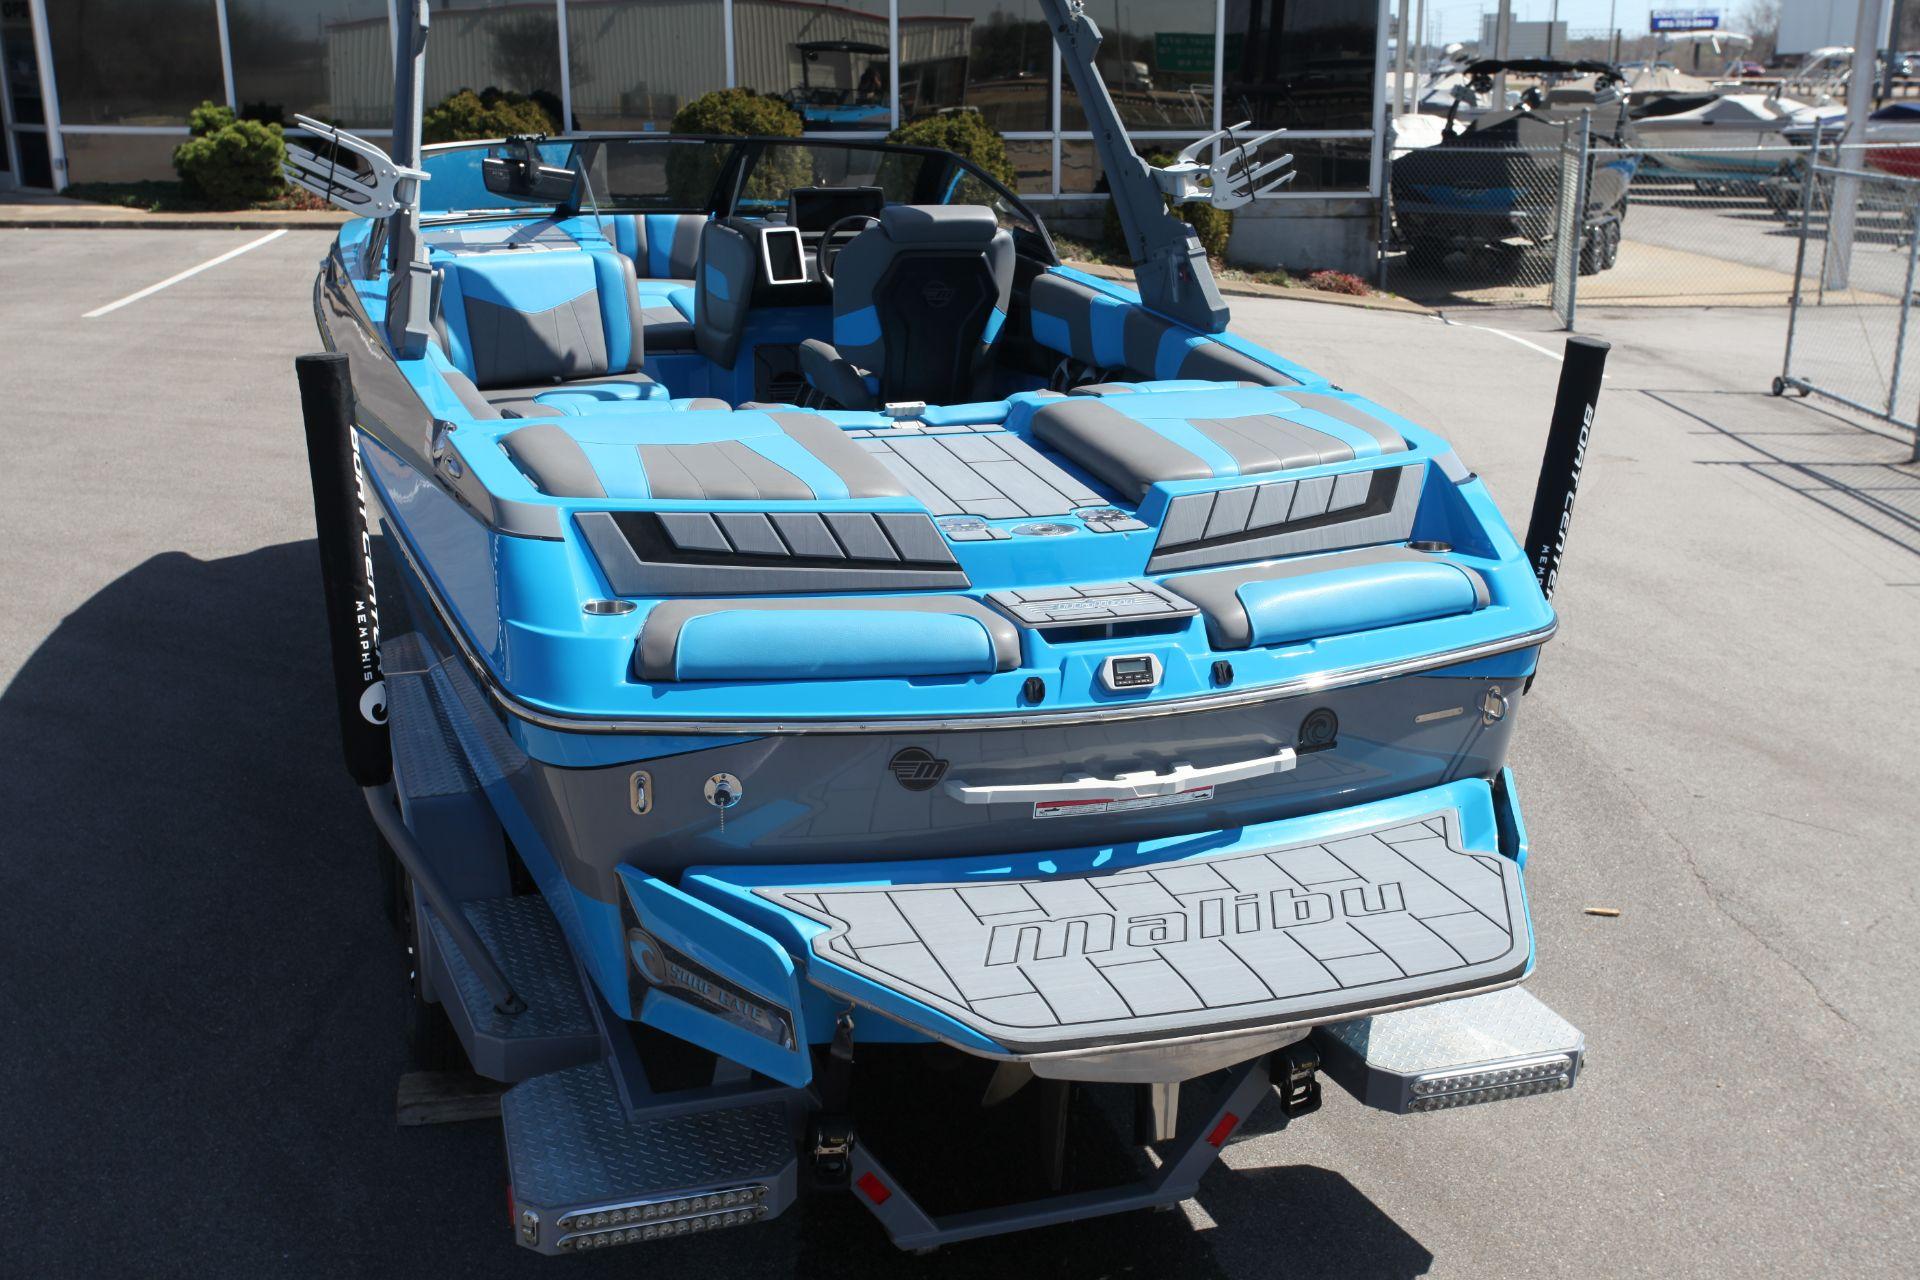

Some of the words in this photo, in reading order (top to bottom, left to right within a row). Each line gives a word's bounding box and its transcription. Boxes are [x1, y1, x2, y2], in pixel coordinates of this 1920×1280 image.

[349, 424, 367, 521] BOAT
[1571, 402, 1594, 489] BOAT
[1537, 544, 1551, 587] MEMP
[355, 600, 373, 681] MEMPHIS
[984, 882, 1407, 967] malibu
